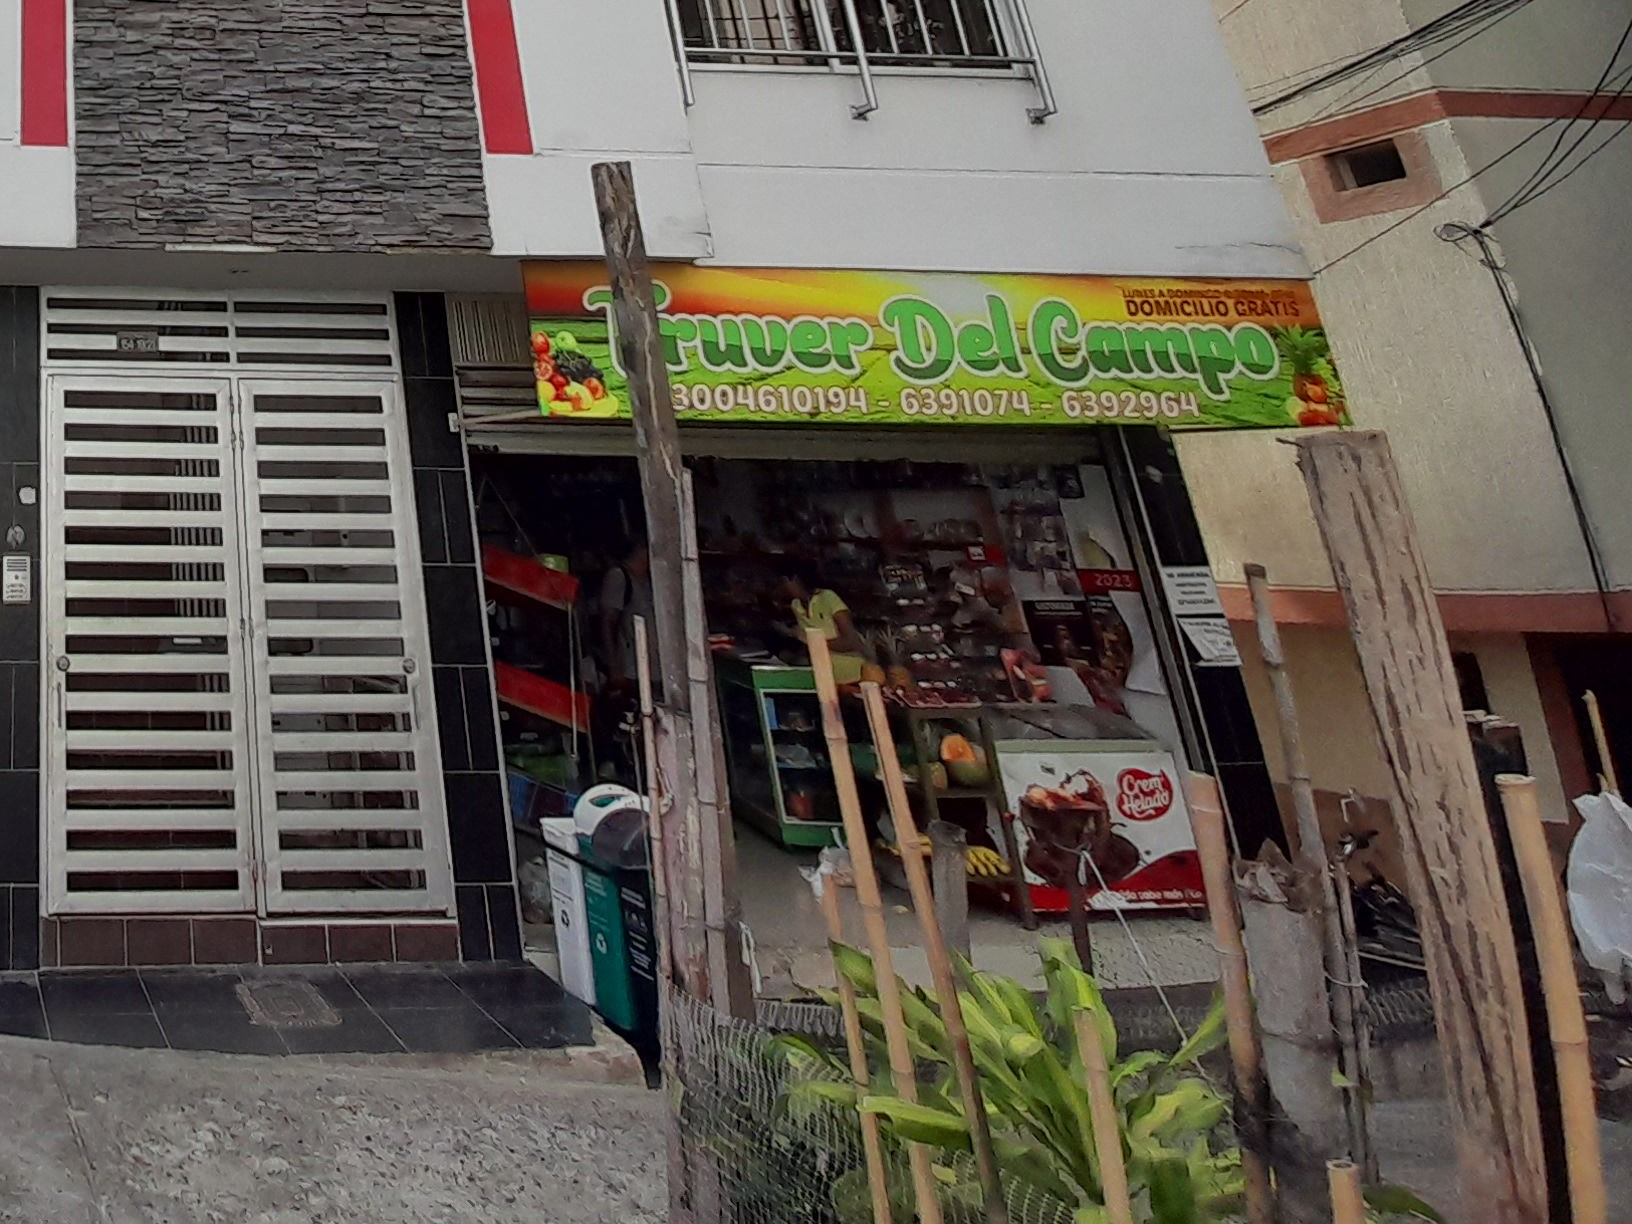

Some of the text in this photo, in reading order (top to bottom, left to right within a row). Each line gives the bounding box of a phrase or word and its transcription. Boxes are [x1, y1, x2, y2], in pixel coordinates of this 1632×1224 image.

[1125, 299, 1300, 317] DOMICILIO GRATIS
[880, 293, 1029, 385] Del
[1028, 297, 1279, 401] Campo
[671, 383, 869, 414] 3004610194
[900, 388, 1031, 417] 6391074
[1061, 390, 1201, 418] 6392964
[1121, 774, 1165, 796] Crem
[1121, 791, 1169, 813] Helado
